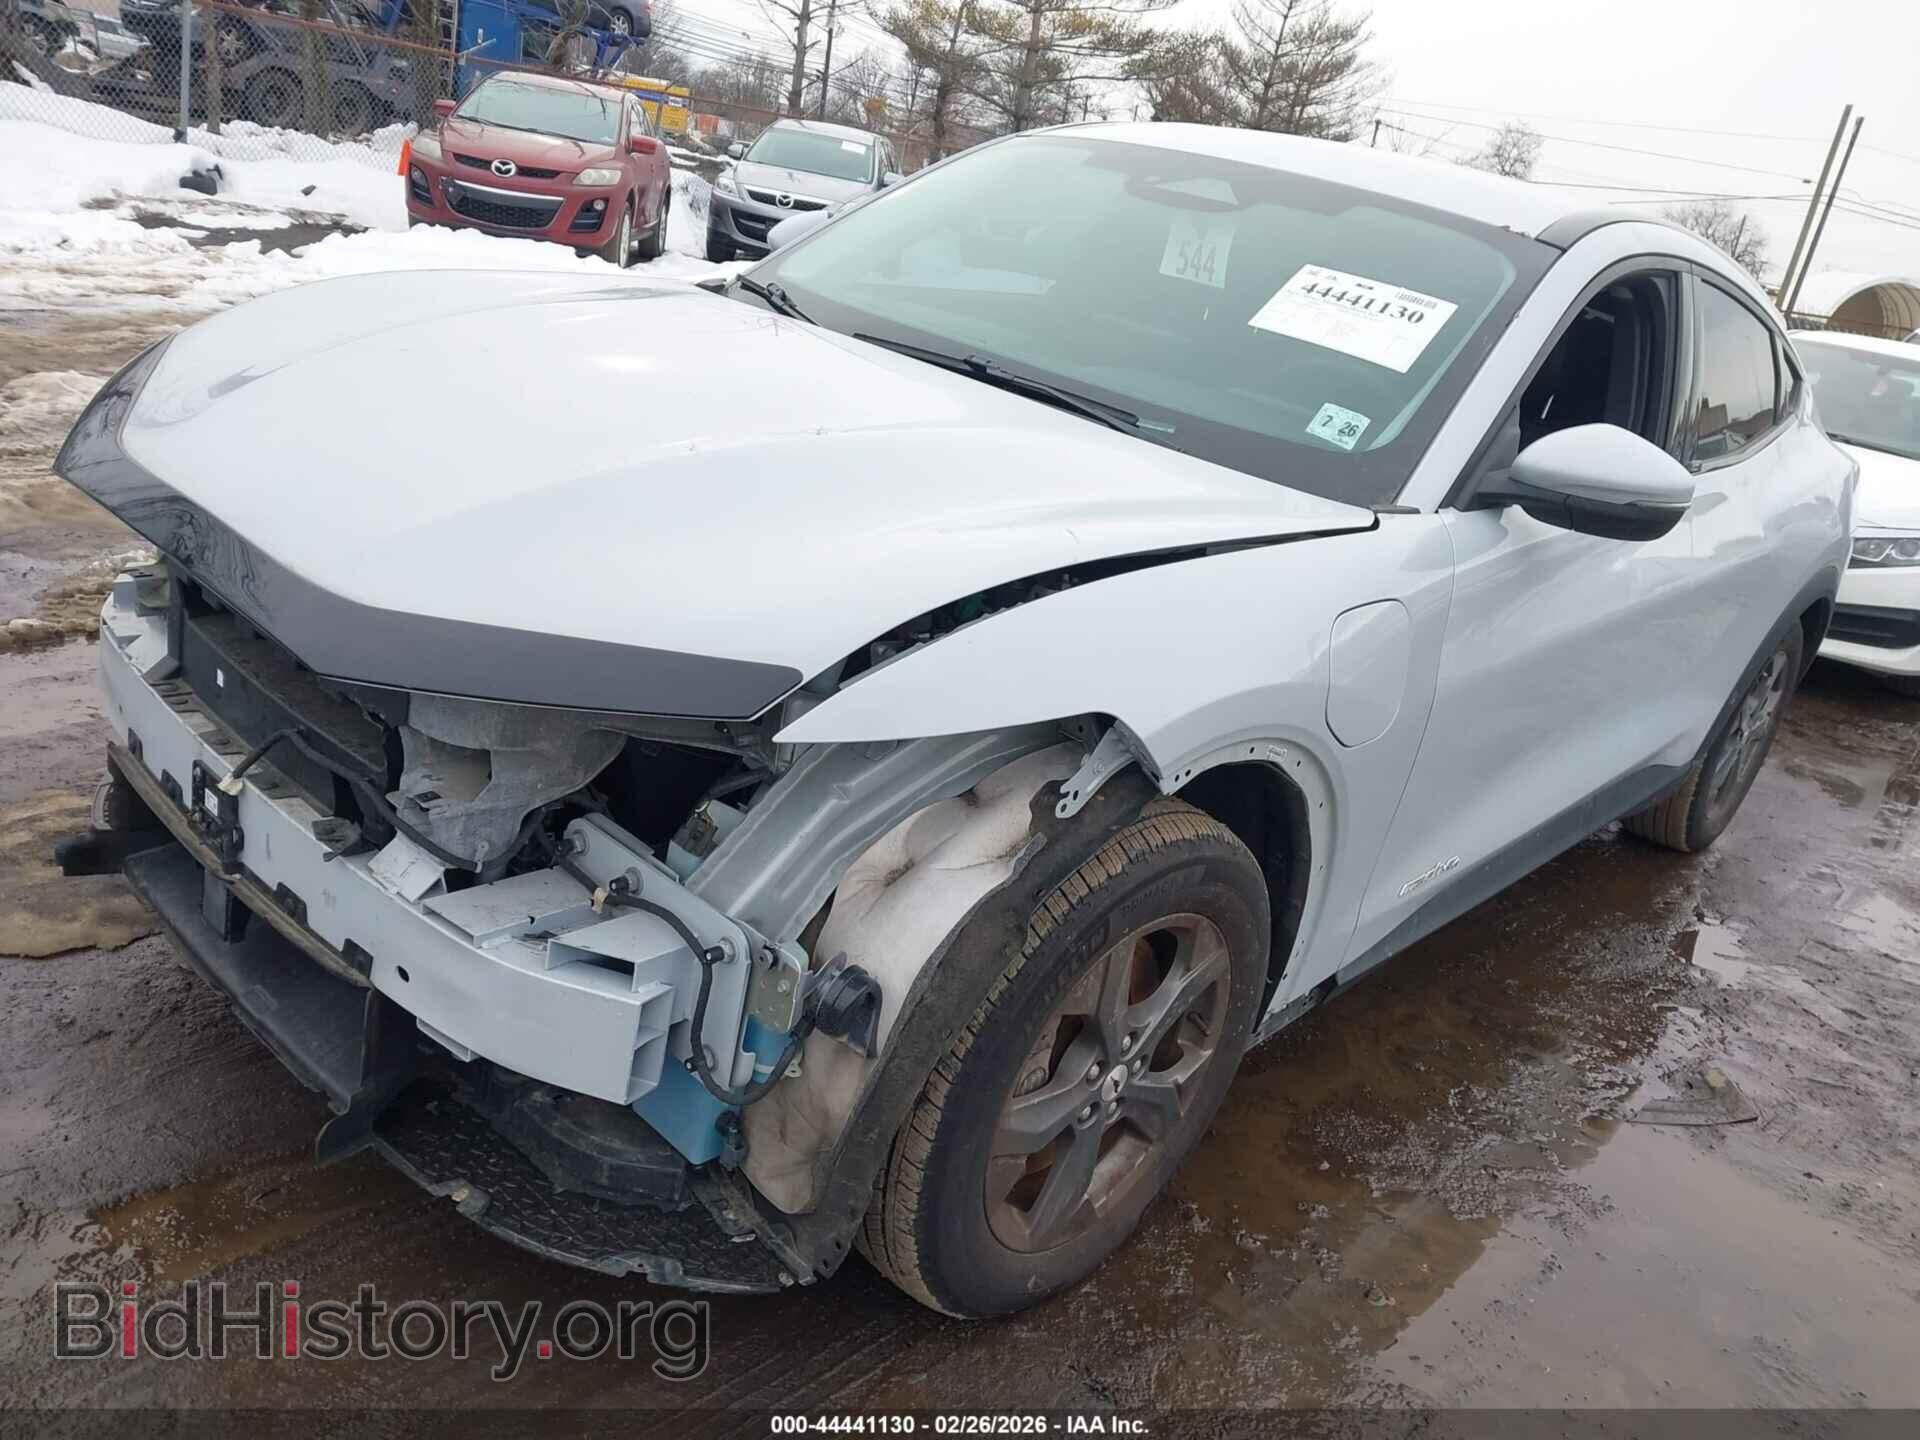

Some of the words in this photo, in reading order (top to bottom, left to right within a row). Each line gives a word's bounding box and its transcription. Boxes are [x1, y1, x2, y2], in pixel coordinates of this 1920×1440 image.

[1177, 240, 1217, 282] 544
[1301, 283, 1425, 324] 44441130
[1321, 415, 1334, 428] 7
[1337, 421, 1360, 437] 26
